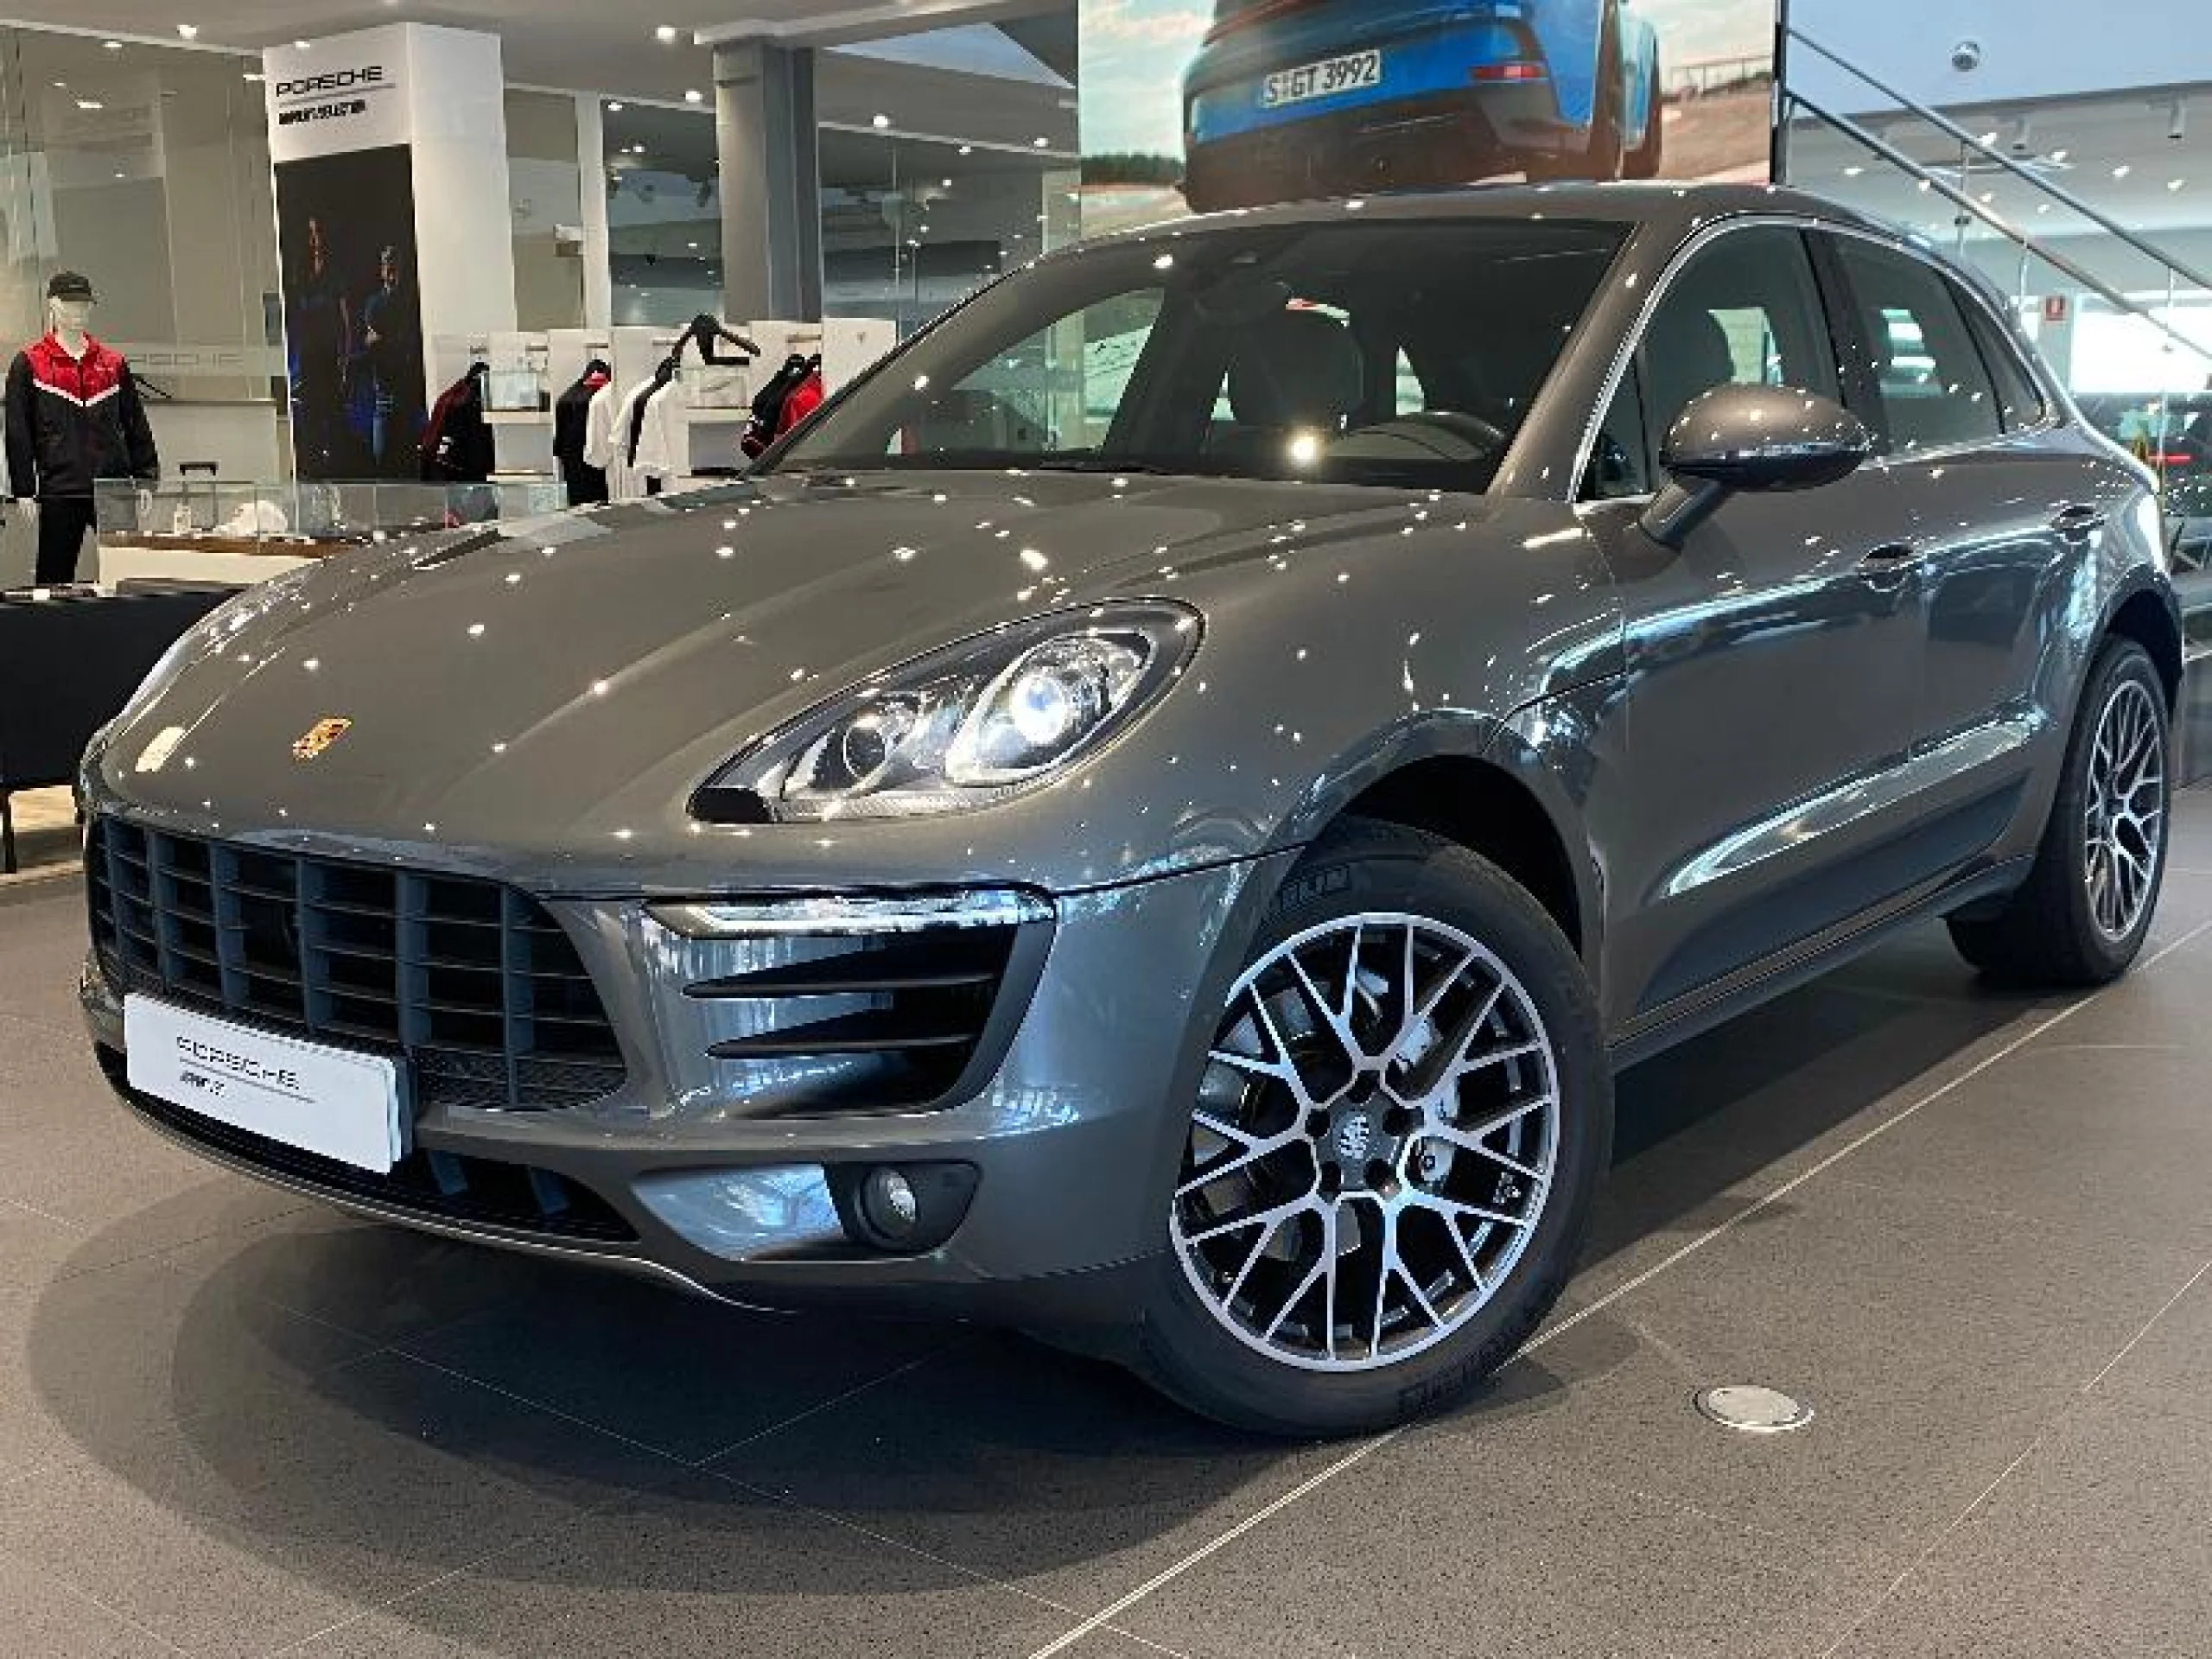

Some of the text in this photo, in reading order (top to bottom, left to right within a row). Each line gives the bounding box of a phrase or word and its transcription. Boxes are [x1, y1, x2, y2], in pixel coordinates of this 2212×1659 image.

[276, 66, 383, 98] PORSCHE
[1321, 54, 1376, 89] 3992
[176, 1036, 301, 1091] PORSCHE
